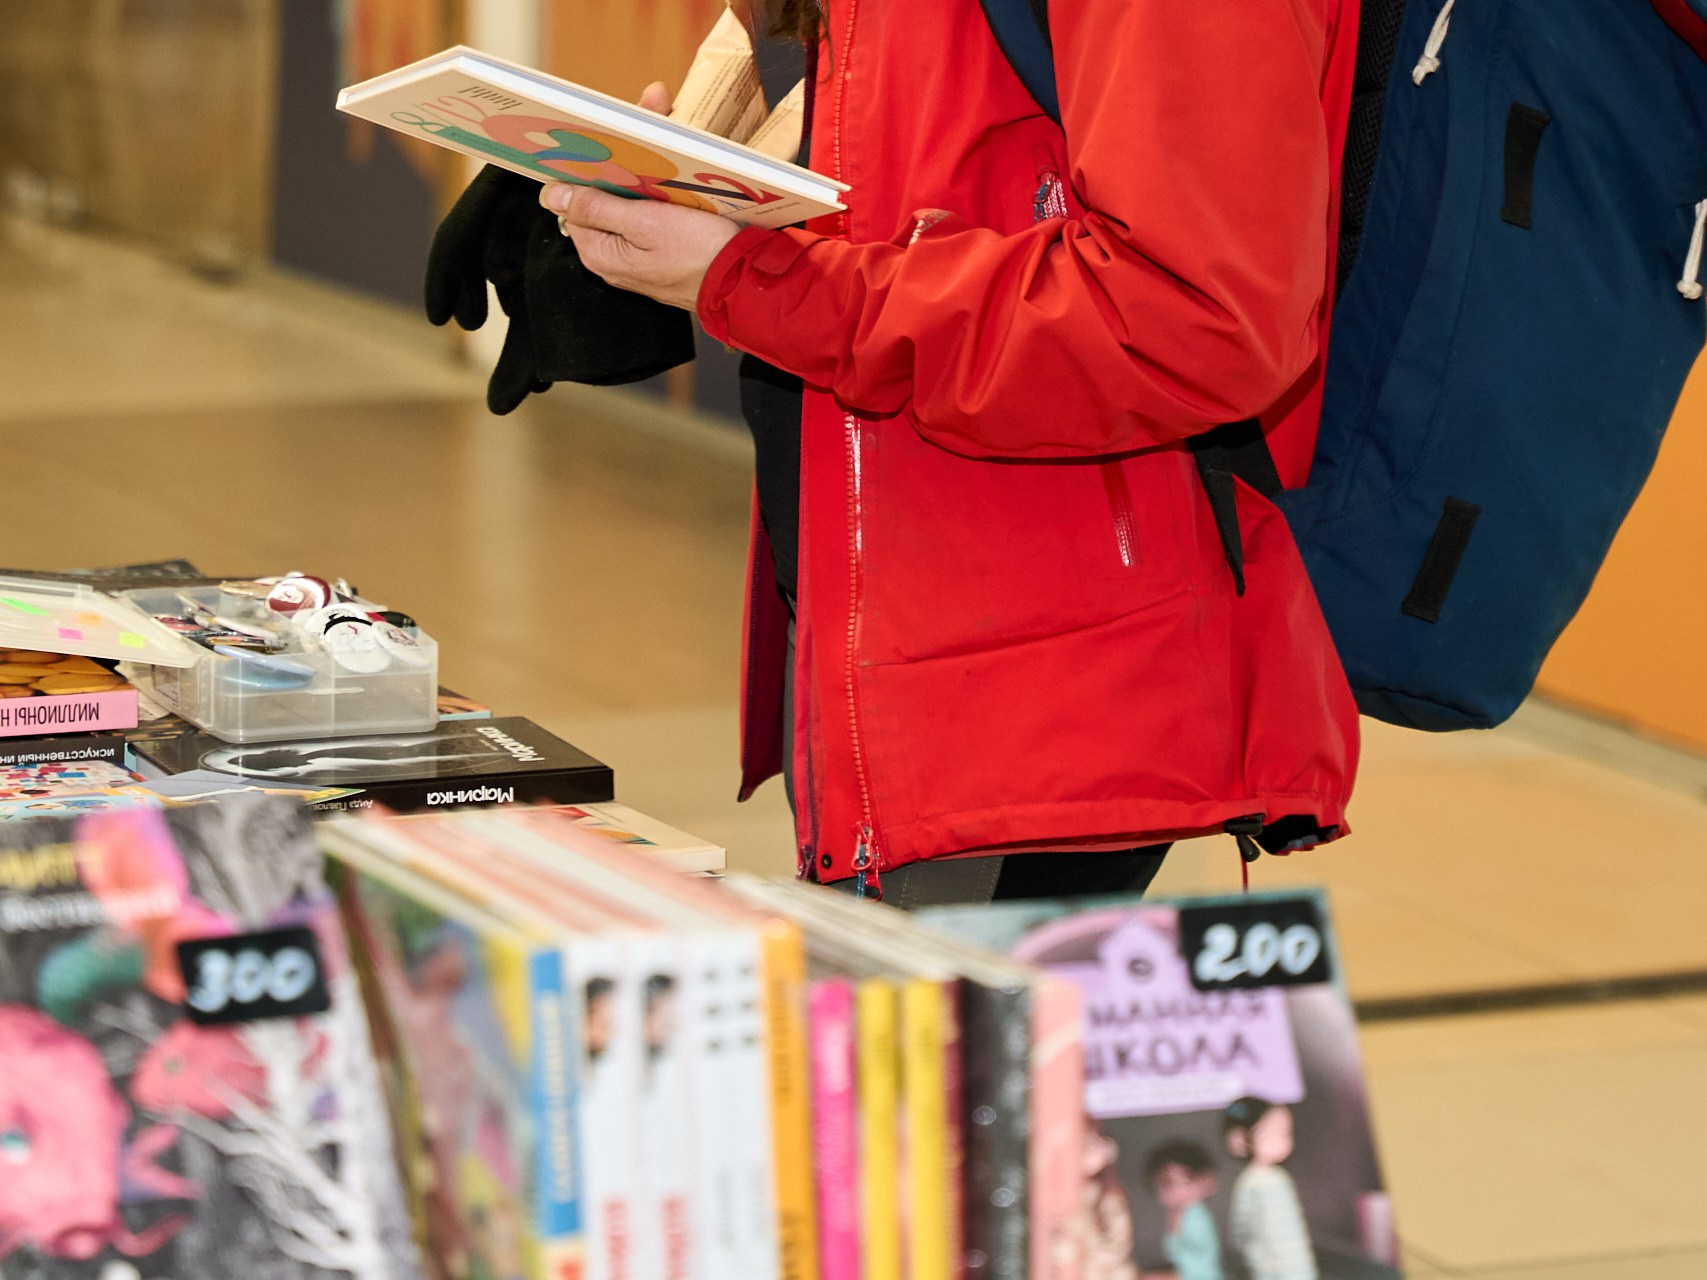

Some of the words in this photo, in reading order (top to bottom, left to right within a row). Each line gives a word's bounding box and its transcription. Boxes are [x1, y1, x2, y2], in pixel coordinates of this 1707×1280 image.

[14, 702, 99, 726] МИЛЛИОНЫ
[17, 747, 115, 766] искусственный
[349, 799, 373, 809] Аида
[428, 786, 514, 807] Маринка
[1193, 920, 1321, 983] 200
[187, 946, 316, 1013] 300
[1088, 993, 1266, 1025] МАННАЯ
